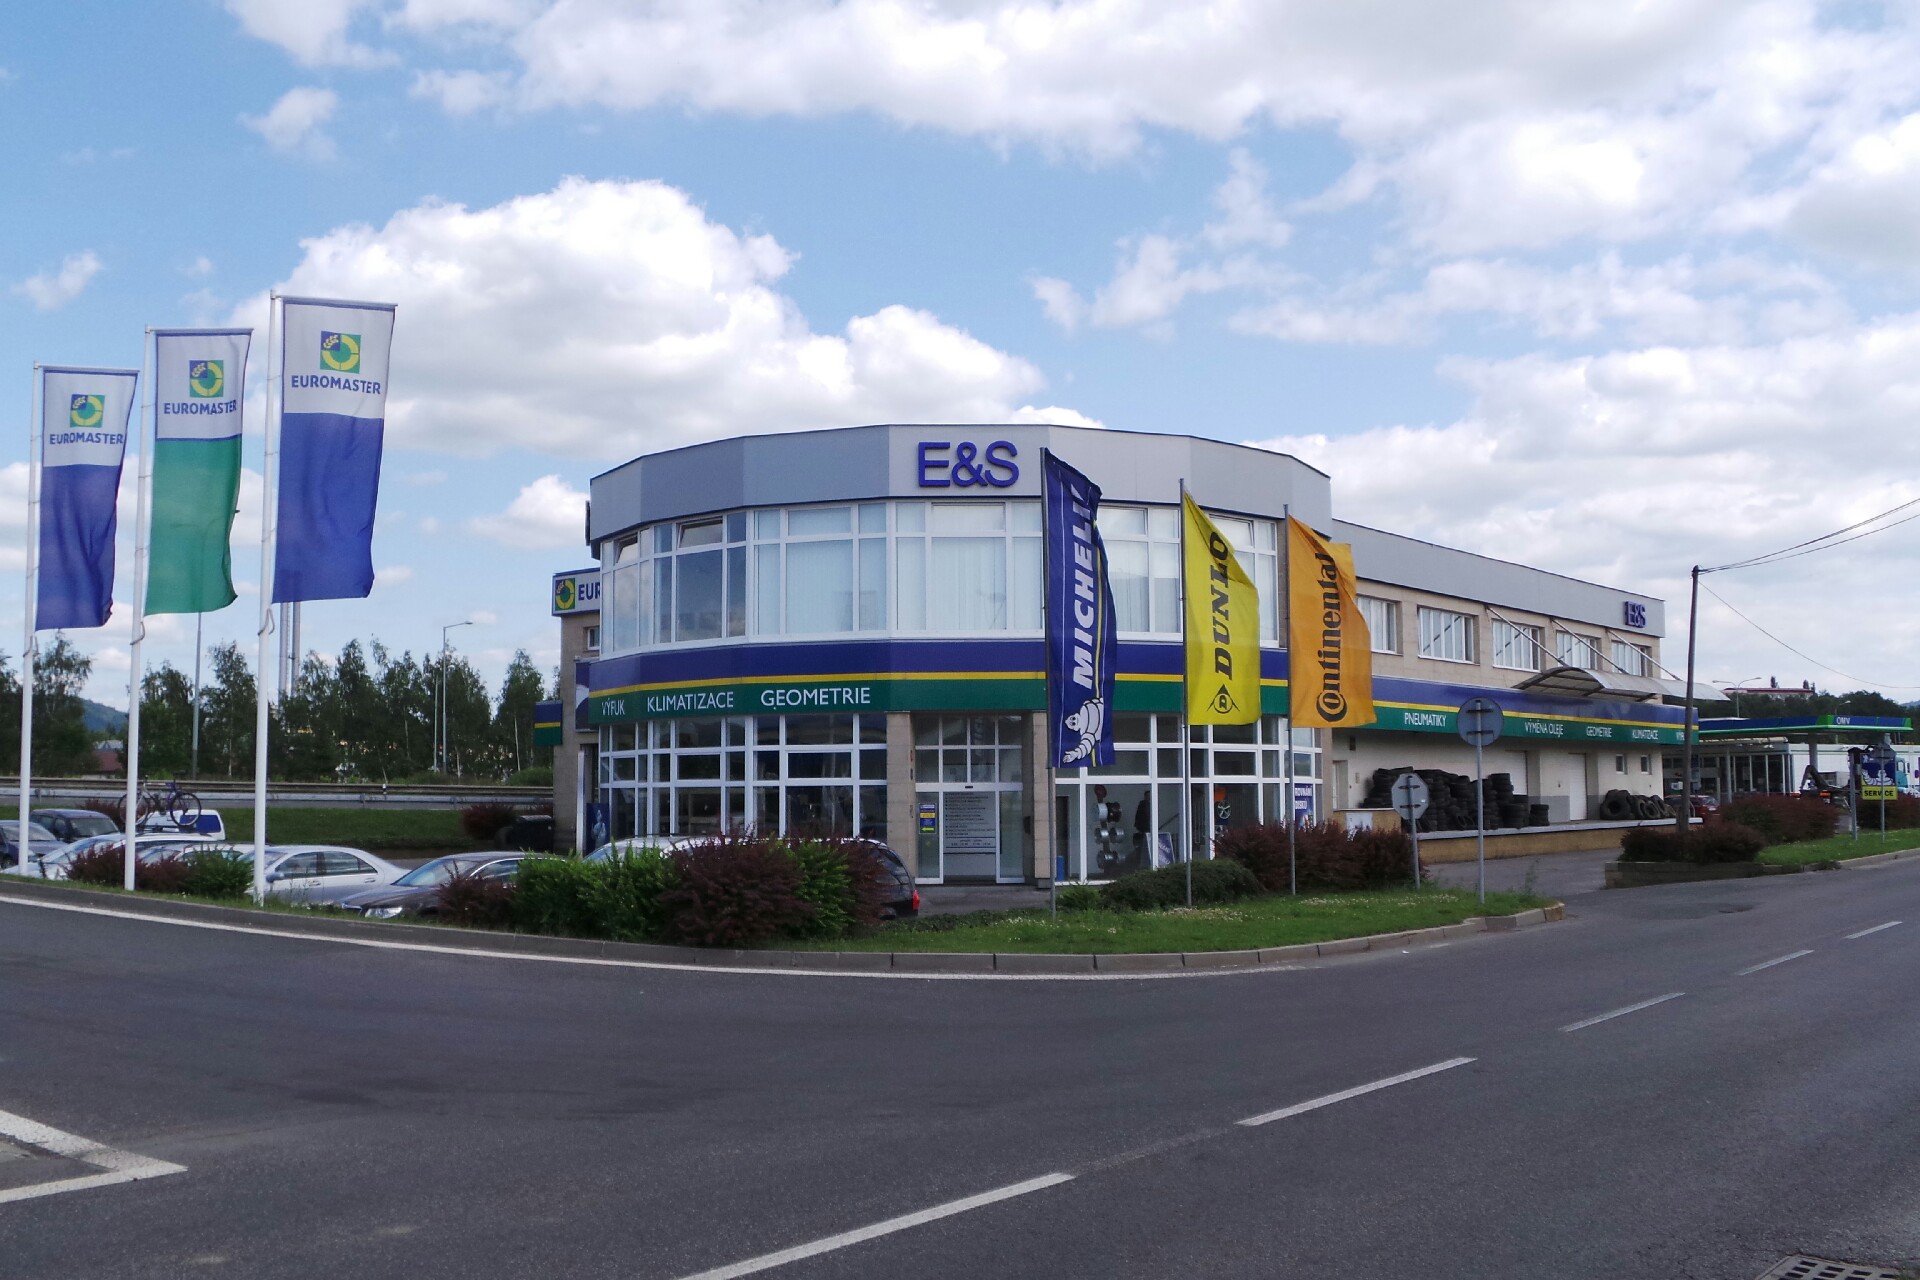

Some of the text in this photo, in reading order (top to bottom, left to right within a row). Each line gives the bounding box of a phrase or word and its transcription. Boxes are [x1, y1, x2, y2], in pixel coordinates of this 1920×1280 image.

[291, 374, 382, 395] EUROMASTER
[163, 399, 237, 416] EUROMASTER
[49, 432, 124, 446] EUROMASTER
[918, 440, 1020, 488] E&S
[1624, 601, 1647, 628] E&S
[1315, 552, 1348, 722] Continental
[601, 687, 872, 716] VÝFUK KLIMATIZACE GEOMETRIE
[1404, 712, 1447, 727] PNEUMATIKY
[1525, 718, 1548, 734] VÝMĚNA
[1549, 723, 1564, 738] OLEJE
[1586, 725, 1612, 738] GEOMETRIE
[1632, 729, 1659, 740] KLIMATIZACE
[1836, 716, 1851, 725] OMV
